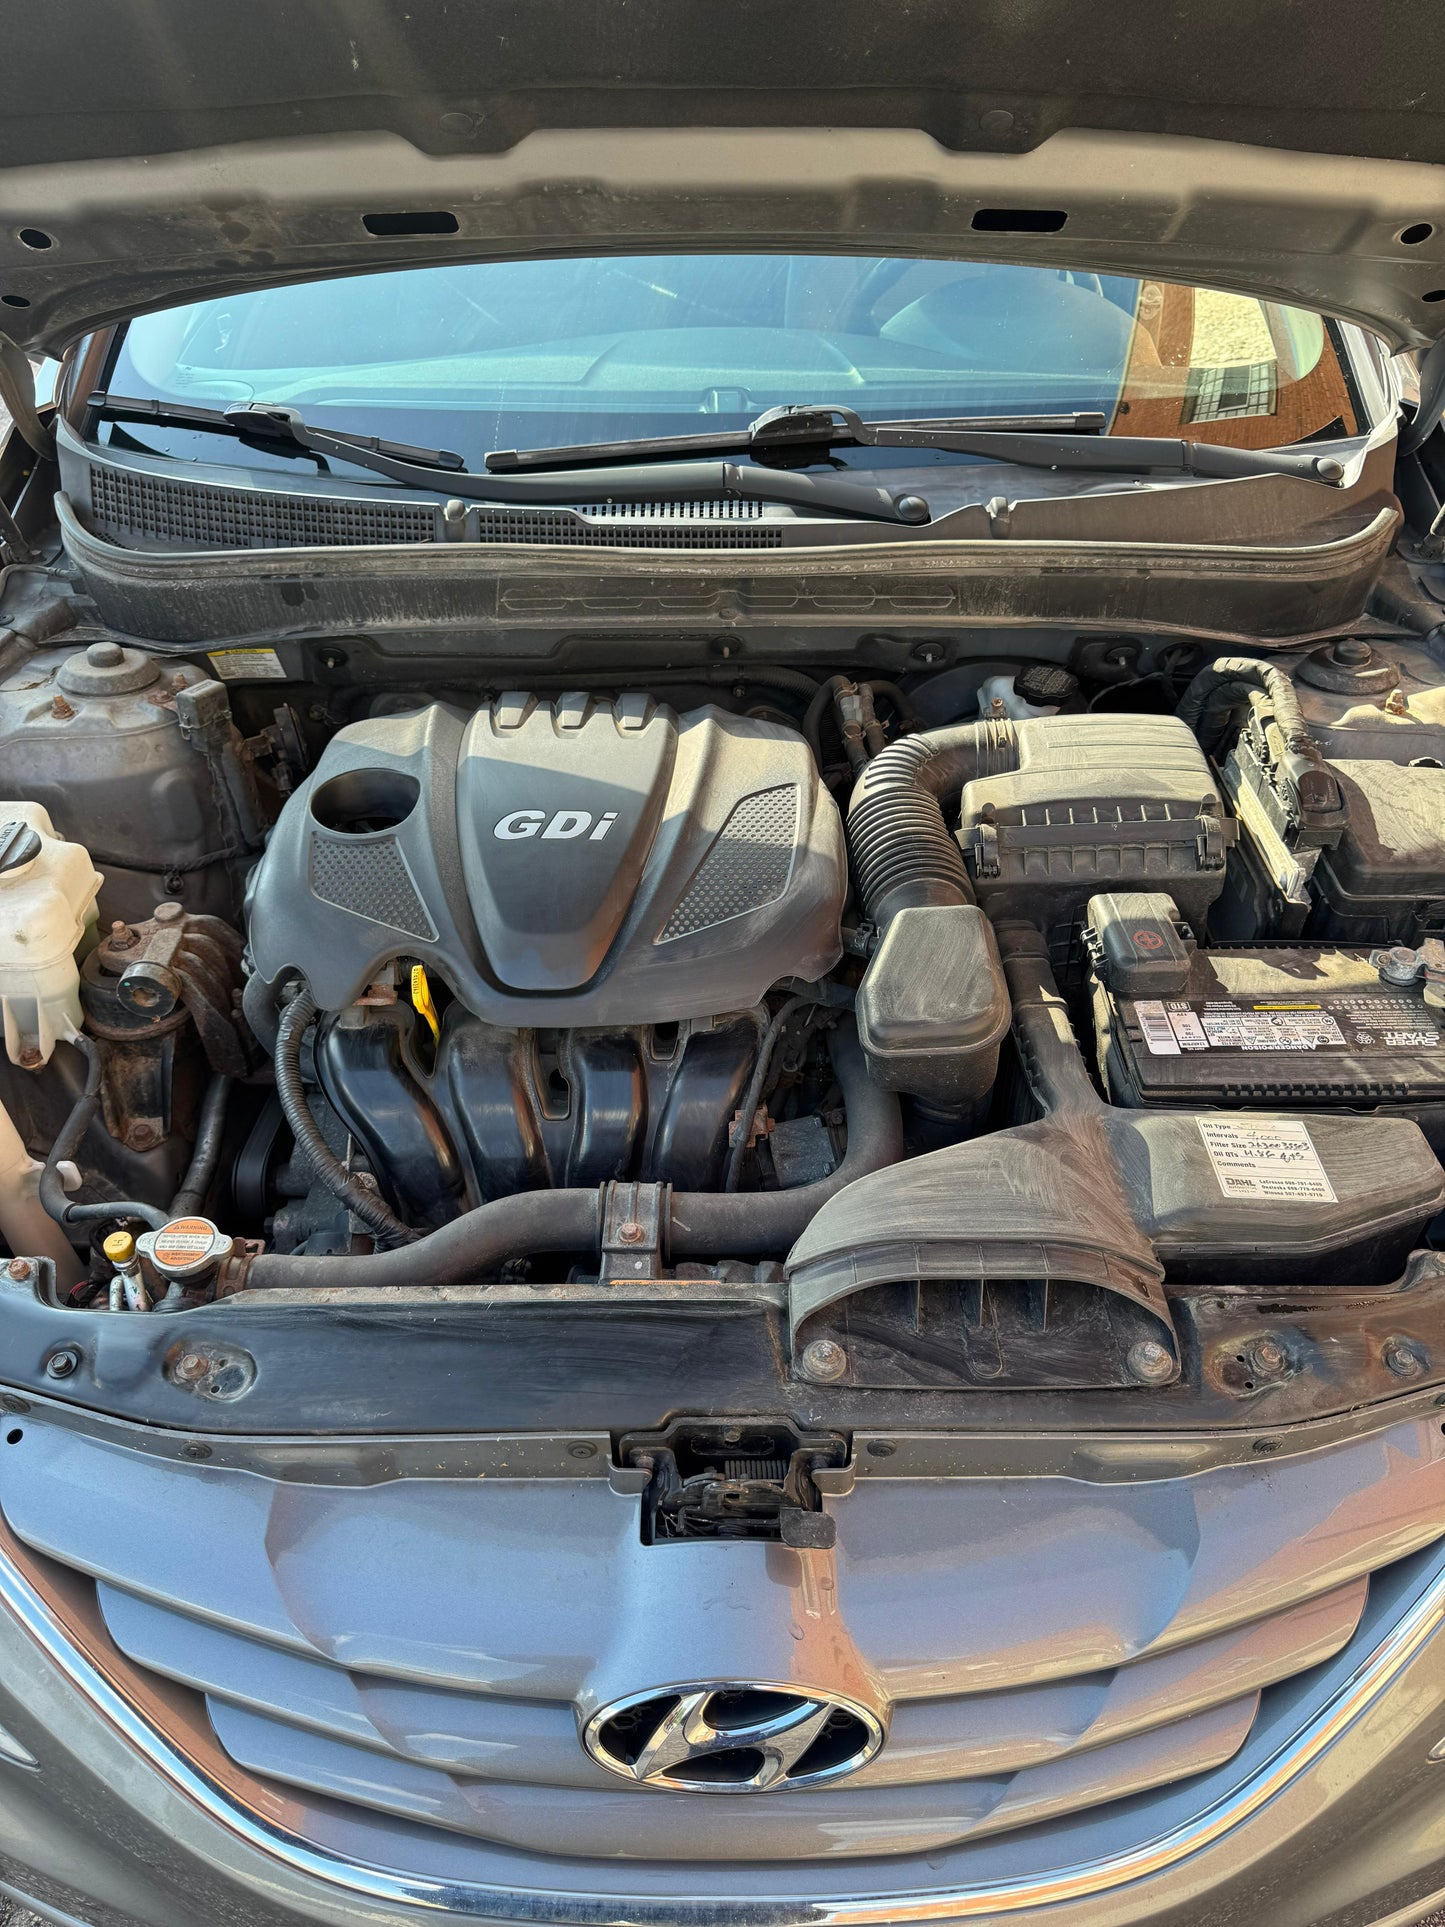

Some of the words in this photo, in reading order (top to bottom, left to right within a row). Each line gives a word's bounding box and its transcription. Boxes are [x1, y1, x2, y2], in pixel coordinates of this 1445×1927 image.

[493, 809, 620, 840] GDi
[1384, 1032, 1439, 1040] START
[1225, 1178, 1256, 1186] DAHL
